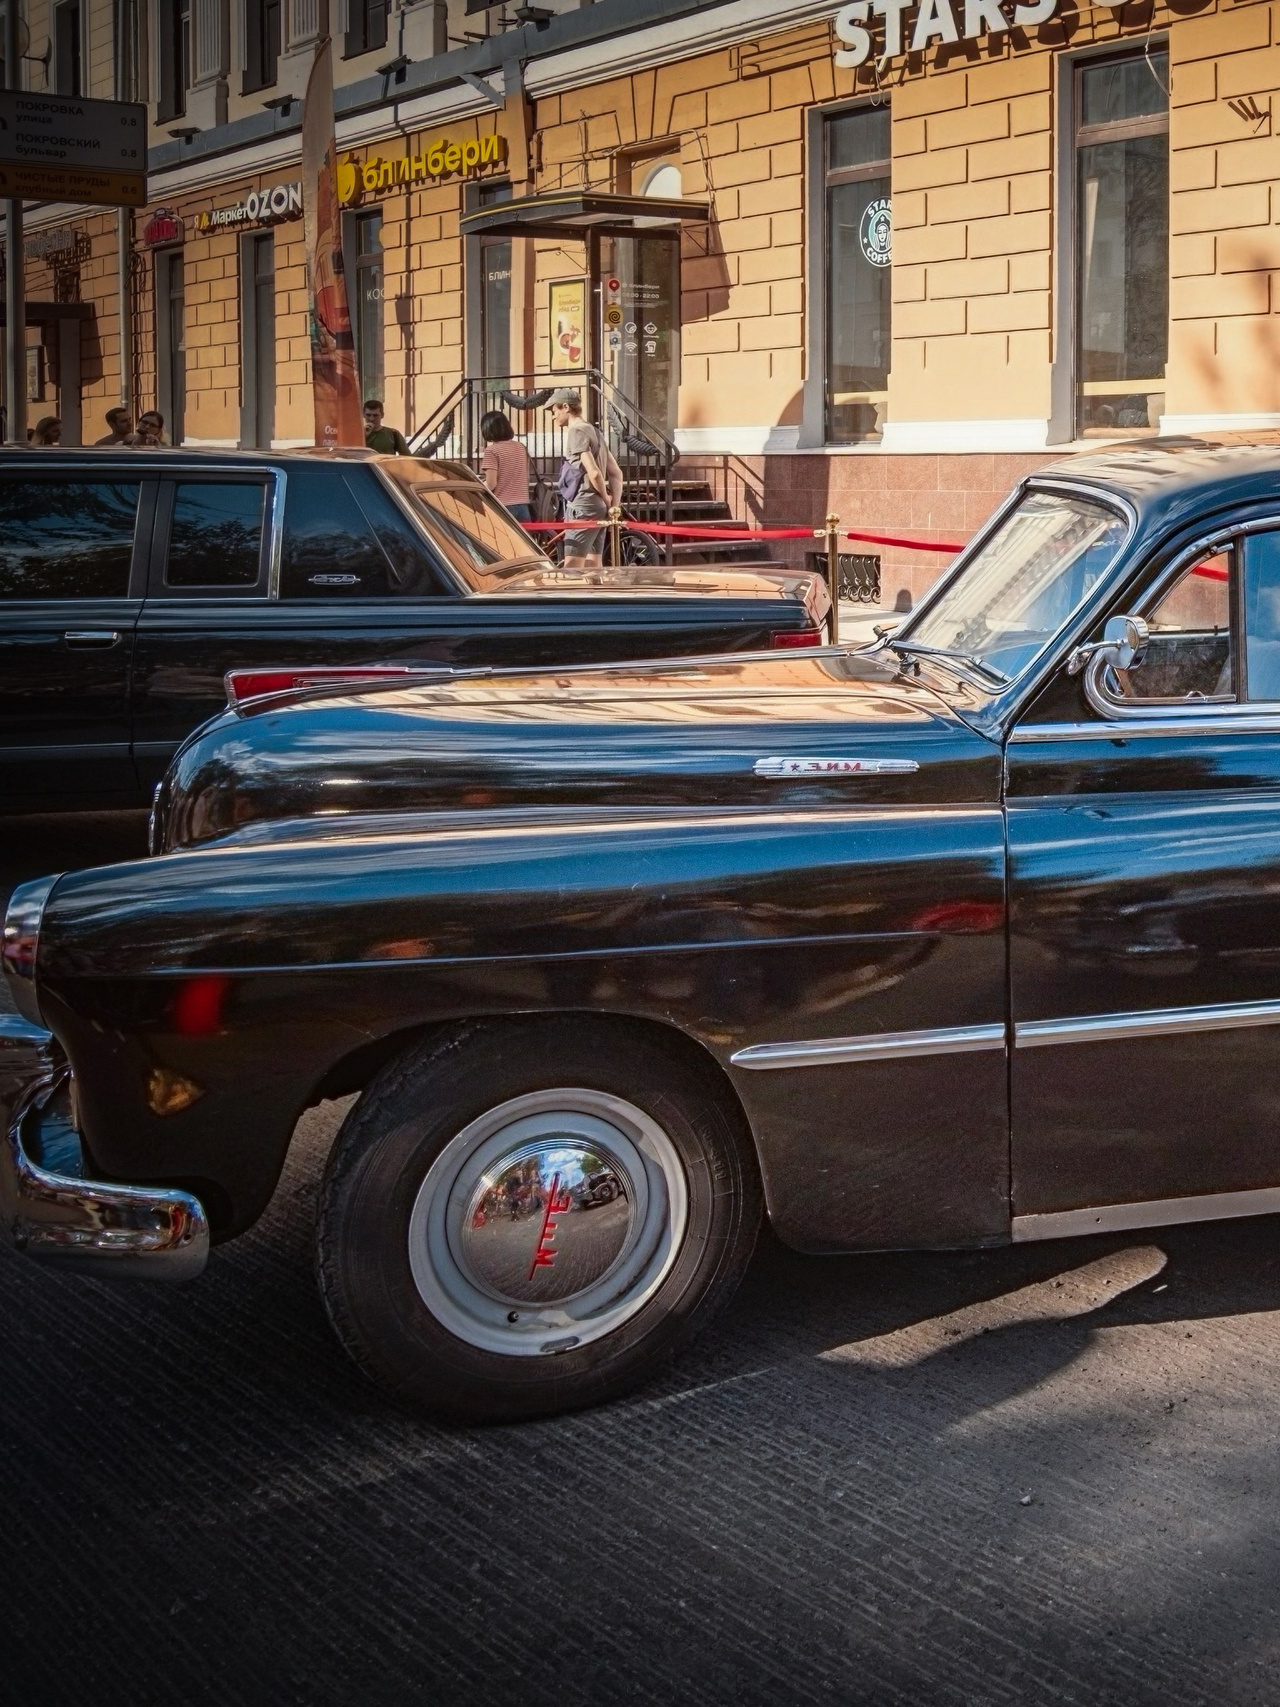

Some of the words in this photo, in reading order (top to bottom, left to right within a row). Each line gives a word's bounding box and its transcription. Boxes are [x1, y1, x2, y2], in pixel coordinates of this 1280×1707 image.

[16, 101, 84, 115] ПОКРОВКА
[16, 114, 52, 124] улица
[121, 117, 137, 126] 0.8
[16, 133, 101, 149] ПОКРОВСКИЙ
[15, 145, 67, 158] бульвар
[121, 149, 137, 158] 0.8
[362, 135, 500, 191] блинбери
[15, 172, 65, 184] ЧИСТЫЕ
[69, 175, 110, 188] ПРУДЫ
[15, 184, 66, 195] клубный
[69, 189, 91, 197] дом
[122, 185, 137, 195] 0.6
[247, 182, 302, 219] OZON
[211, 206, 247, 226] Маркет
